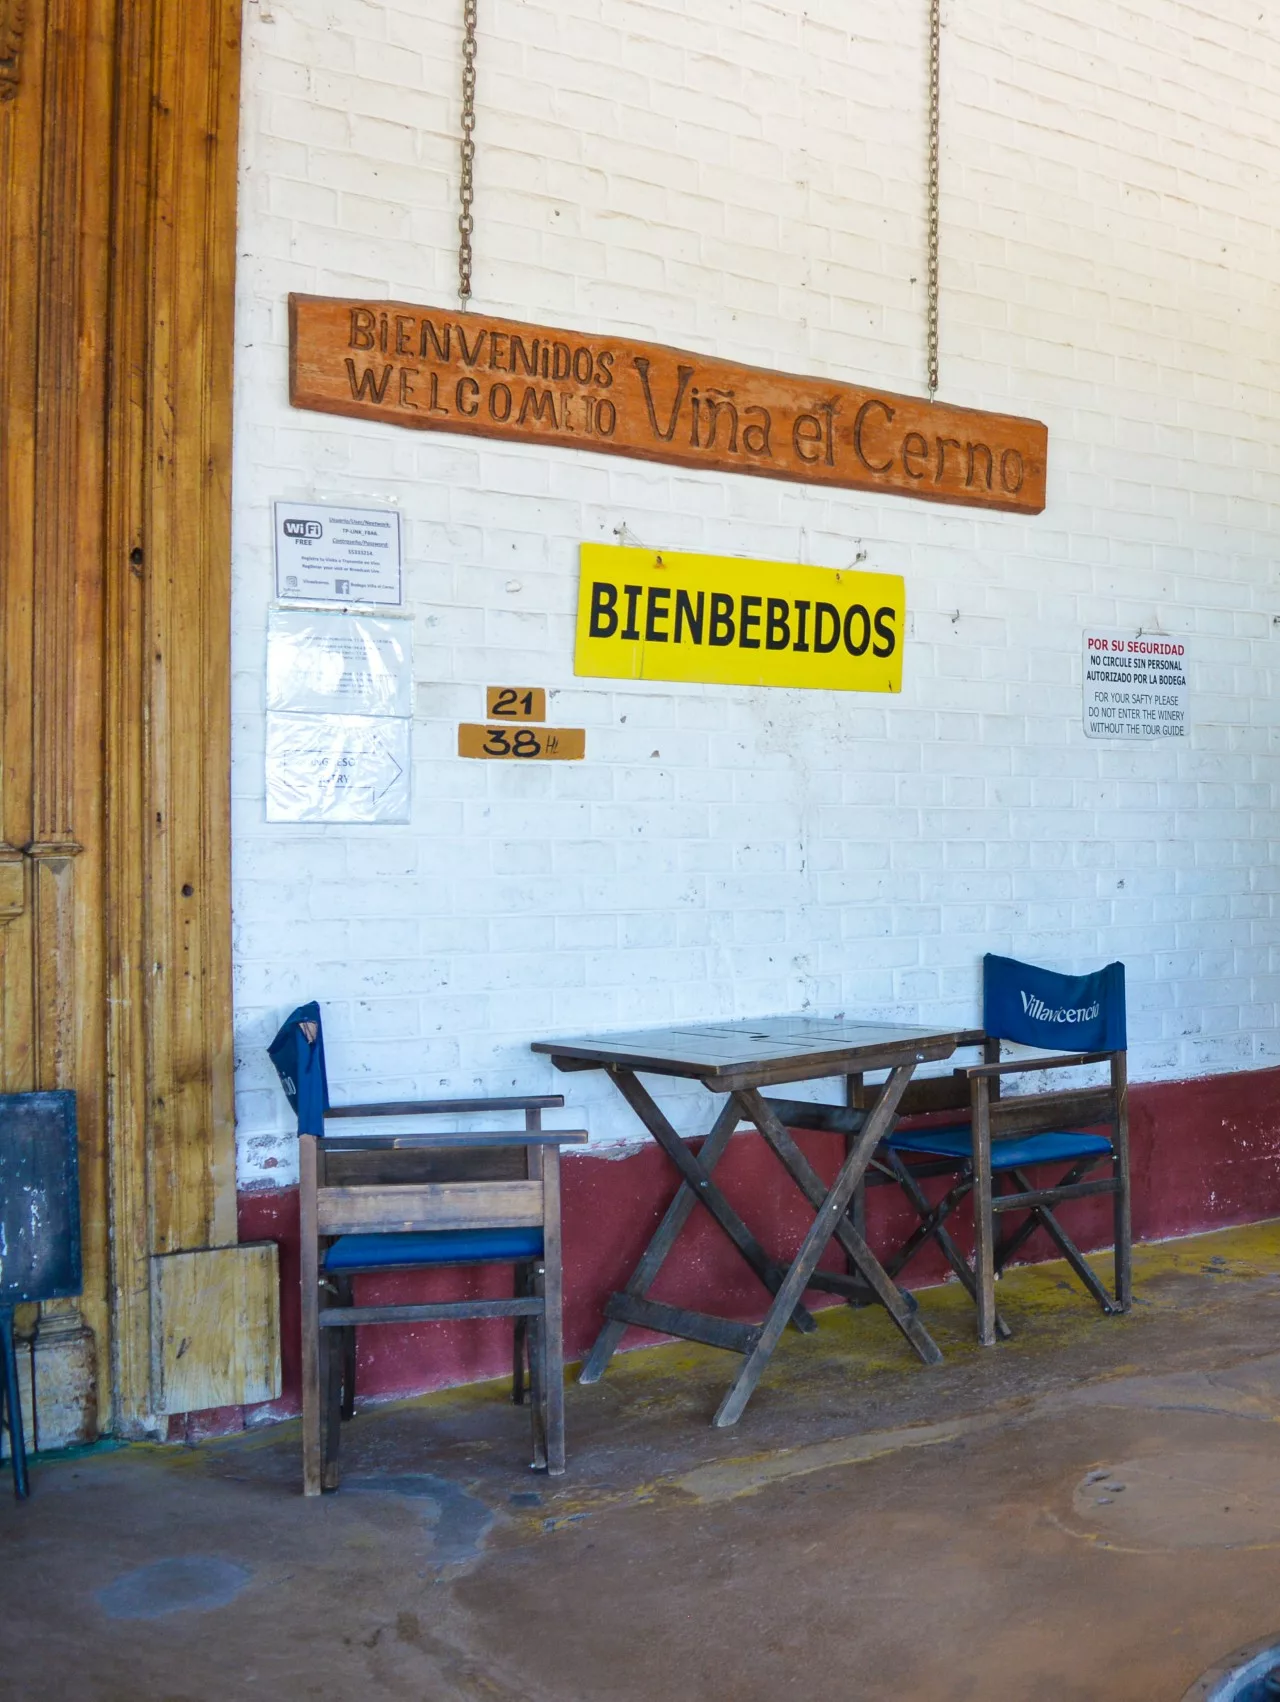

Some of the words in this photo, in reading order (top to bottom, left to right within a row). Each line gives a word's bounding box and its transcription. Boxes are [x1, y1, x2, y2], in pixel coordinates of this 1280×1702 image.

[344, 357, 574, 432] WELCOME
[581, 395, 617, 437] TO
[633, 356, 773, 458] Viña
[792, 395, 838, 468] el
[853, 400, 1024, 495] Cerno
[295, 538, 313, 546] FREE
[588, 581, 896, 658] BIENBEBIDOS
[1088, 638, 1109, 651] POR
[1111, 639, 1125, 652] SU
[1127, 641, 1185, 656] SEGURIDAD
[1090, 655, 1101, 666] NO
[1103, 656, 1132, 668] CIRCULE
[1134, 658, 1146, 669] SIN
[1148, 659, 1182, 671] PERSONAL
[1087, 670, 1131, 683] AUTORIZADO
[1133, 673, 1148, 684] POR
[1149, 675, 1158, 685] LA
[1159, 675, 1186, 686] BODEGA
[492, 689, 533, 715] 21
[1095, 691, 1108, 703] FOR
[1111, 692, 1130, 704] YOUR
[1132, 693, 1152, 705] SAFTY
[1155, 695, 1179, 706] PLEASE
[1089, 706, 1100, 718] DO
[1101, 707, 1116, 718] NOT
[1118, 708, 1140, 719] ENTER
[1142, 709, 1156, 720] THE
[1158, 710, 1185, 721] WINERY
[1090, 722, 1124, 734] WITHOUT
[1126, 723, 1140, 735] THE
[1142, 724, 1161, 735] TOUR
[1163, 725, 1184, 736] GUIDE
[483, 730, 541, 758] 38
[1020, 990, 1100, 1023] Villavicencio
